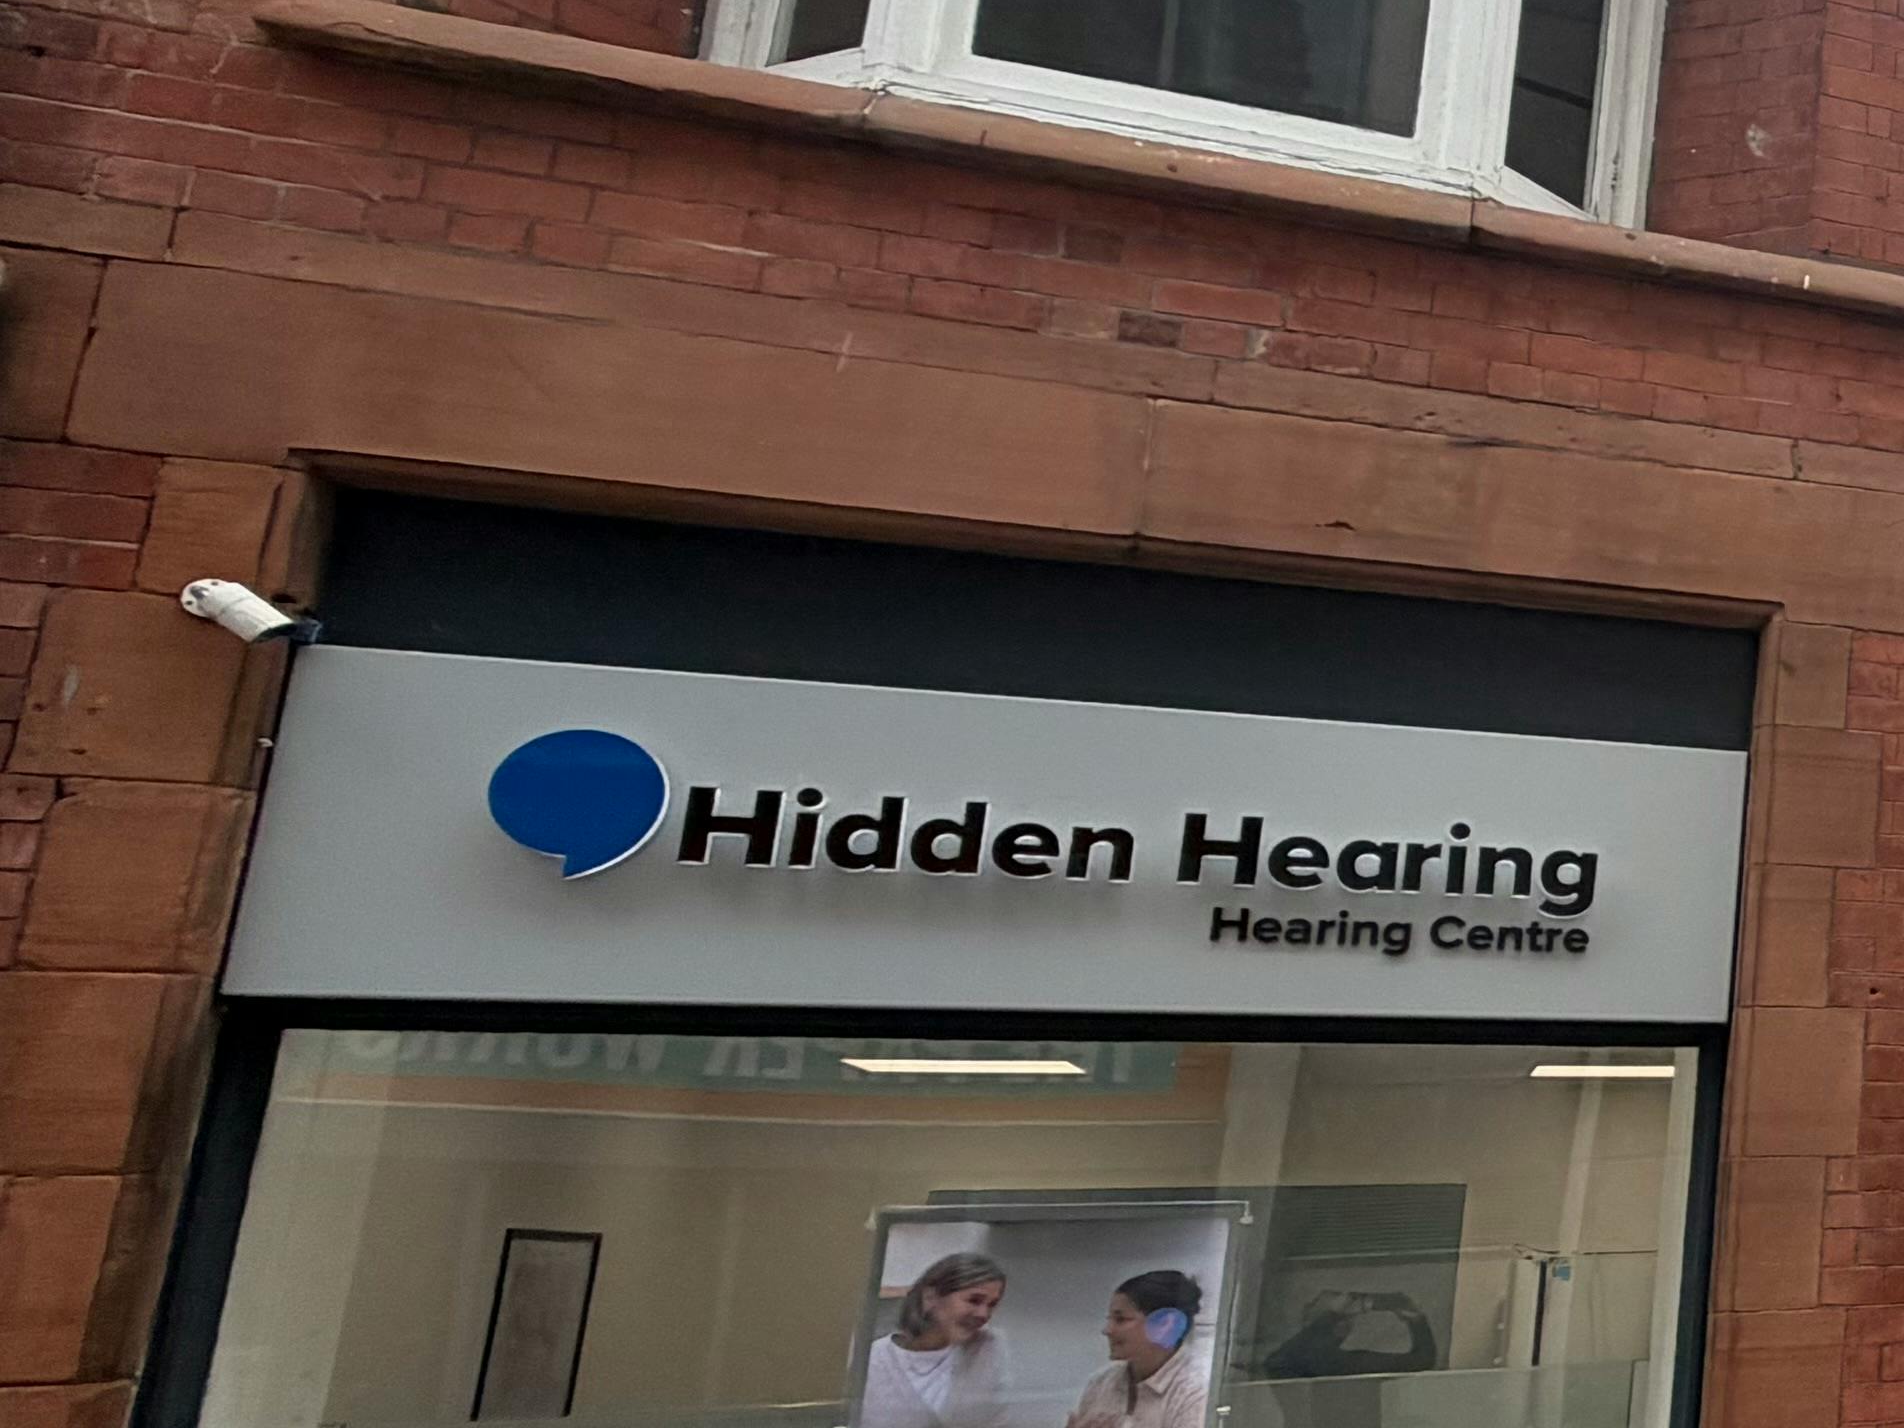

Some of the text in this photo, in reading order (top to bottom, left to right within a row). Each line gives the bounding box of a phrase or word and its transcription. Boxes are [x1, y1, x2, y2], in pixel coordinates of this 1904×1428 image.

[676, 785, 1599, 918] Hidden Hearing
[1209, 906, 1591, 956] Hearing Centre
